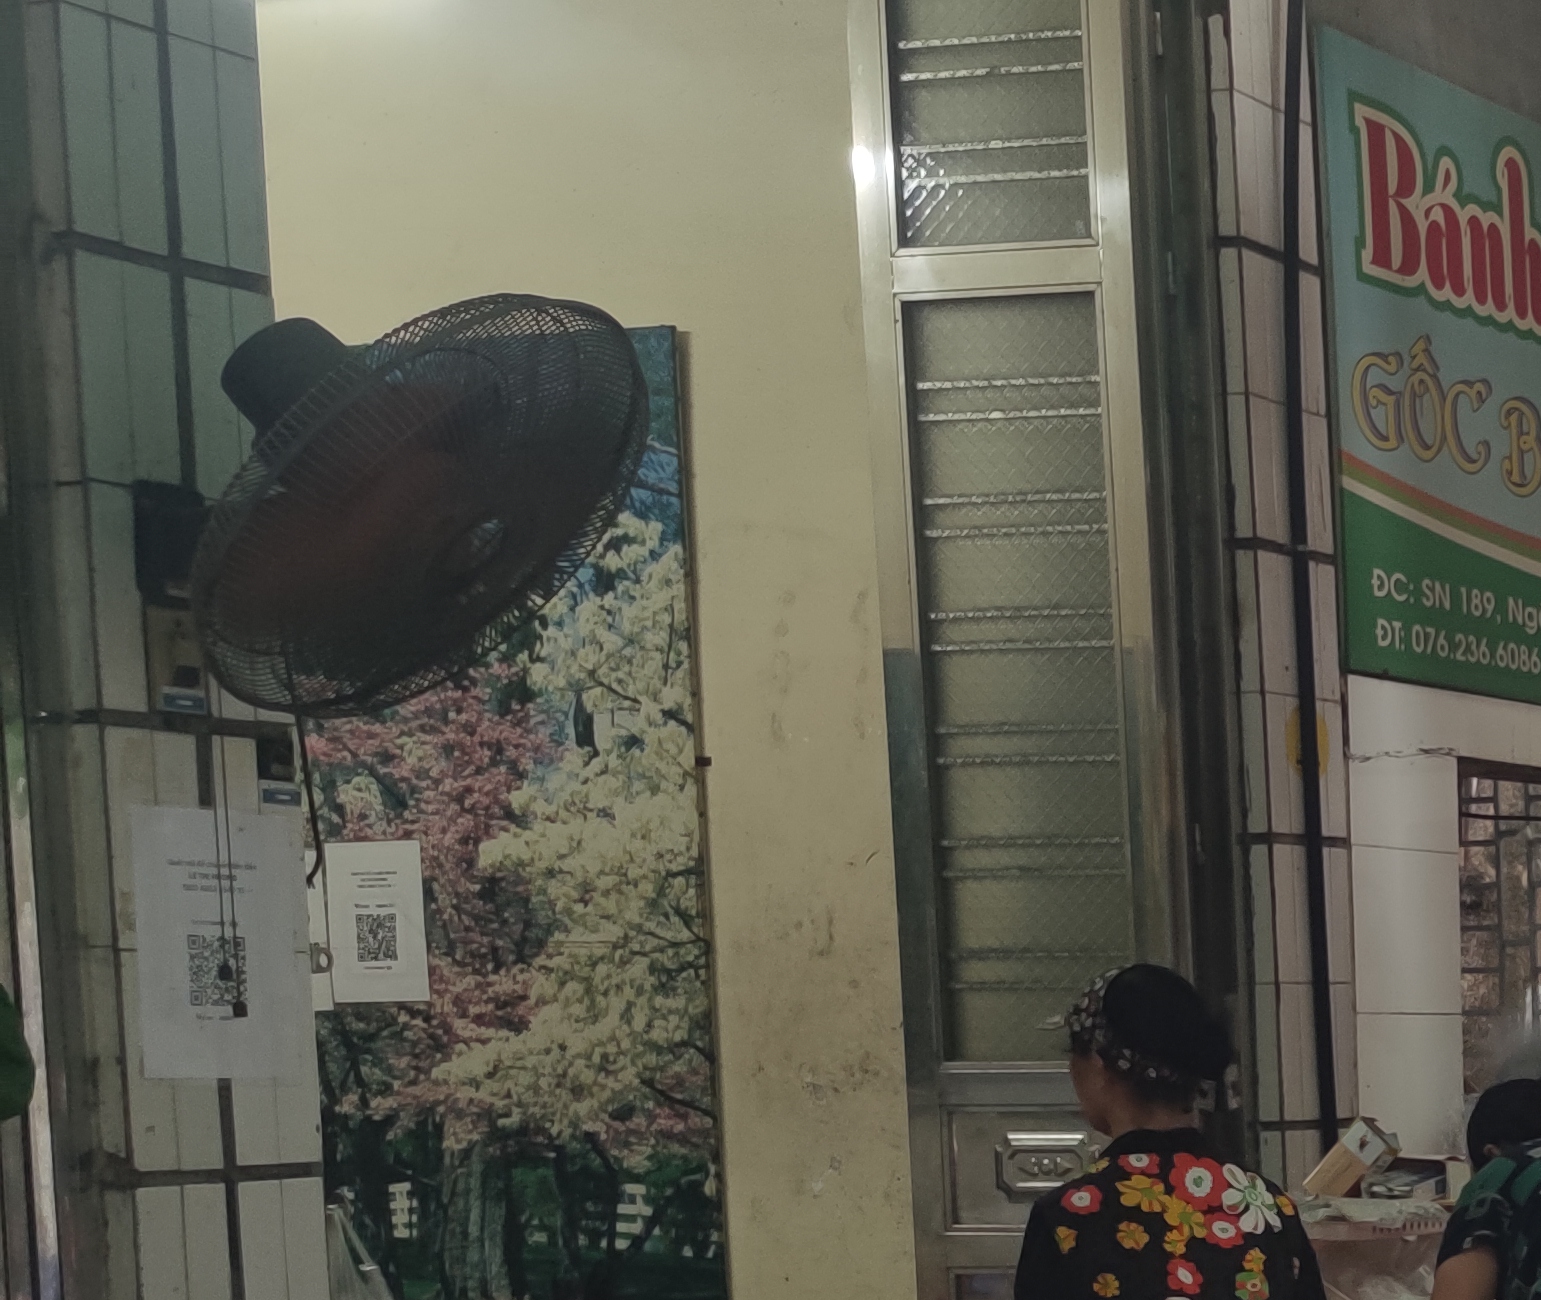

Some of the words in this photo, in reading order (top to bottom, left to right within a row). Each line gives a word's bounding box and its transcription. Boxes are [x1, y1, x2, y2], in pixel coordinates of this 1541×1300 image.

[1352, 332, 1492, 474] GỐC
[1372, 568, 1415, 602] ĐC:
[1421, 577, 1452, 608] SN
[1460, 586, 1502, 626] 189,
[1375, 617, 1405, 652] ĐT:
[1410, 630, 1541, 676] 076.236.6086
